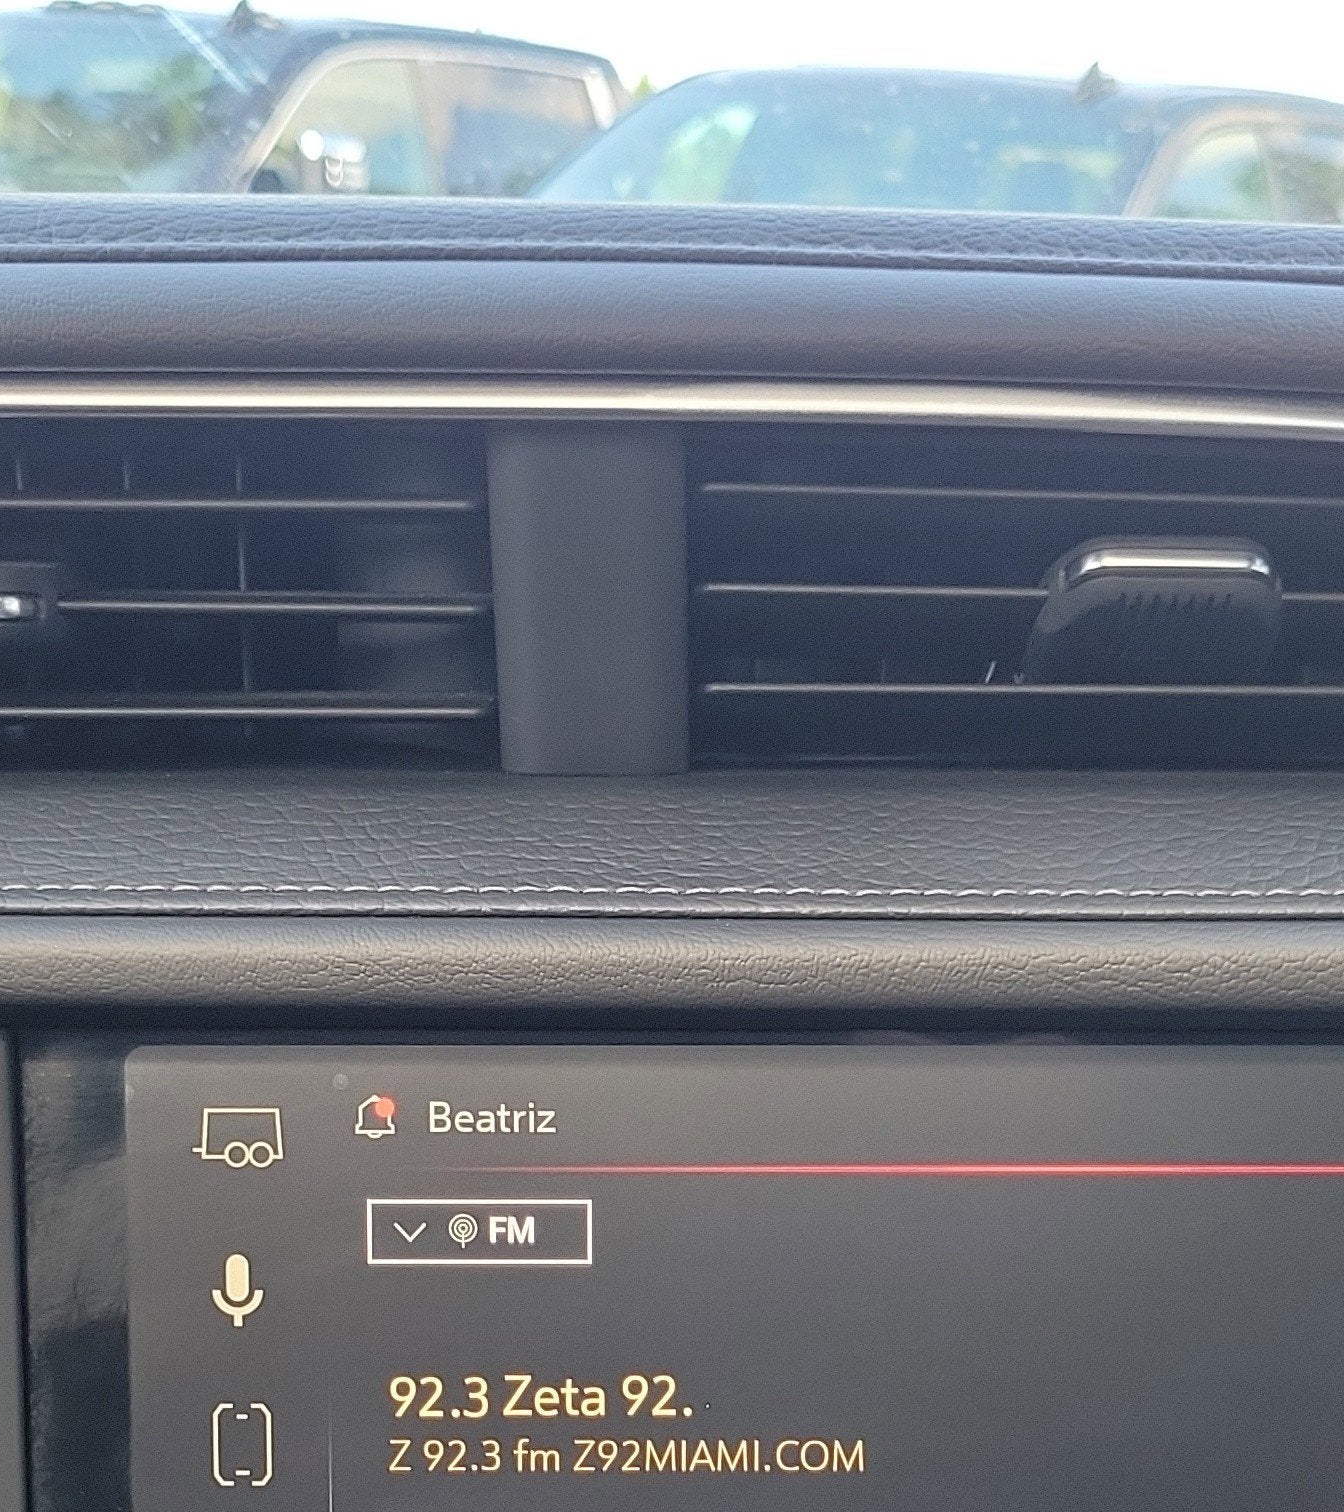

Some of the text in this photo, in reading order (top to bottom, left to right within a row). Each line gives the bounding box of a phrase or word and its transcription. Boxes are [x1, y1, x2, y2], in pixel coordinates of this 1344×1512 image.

[428, 1101, 556, 1134] Beatriz
[488, 1216, 536, 1245] FM
[389, 1374, 693, 1418] 92.3 Zeta 92.
[388, 1438, 865, 1473] Z 92.3 fm Z92MIAMI.COM
